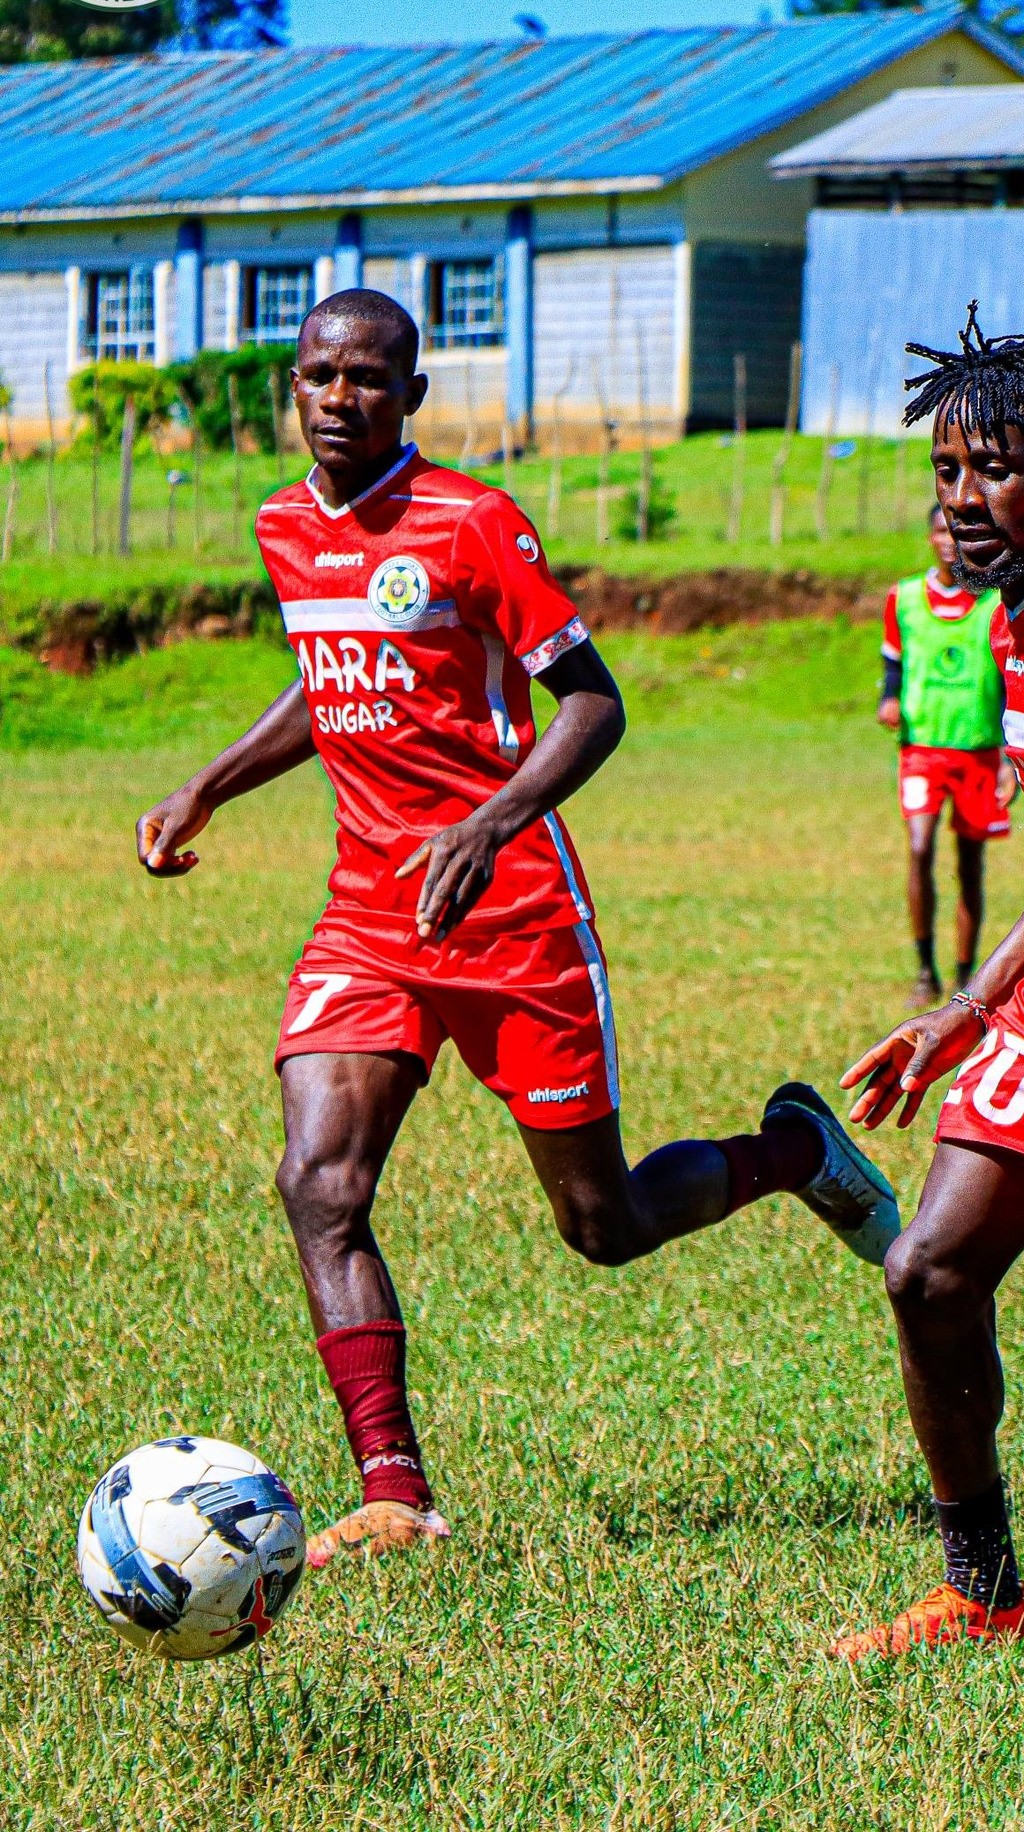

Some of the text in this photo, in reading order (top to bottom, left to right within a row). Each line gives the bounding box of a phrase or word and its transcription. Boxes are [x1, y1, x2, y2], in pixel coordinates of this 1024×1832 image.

[315, 551, 364, 569] uhlsport
[315, 700, 398, 734] SUGAR
[287, 973, 351, 1034] 7
[527, 1081, 589, 1103] uhlsport
